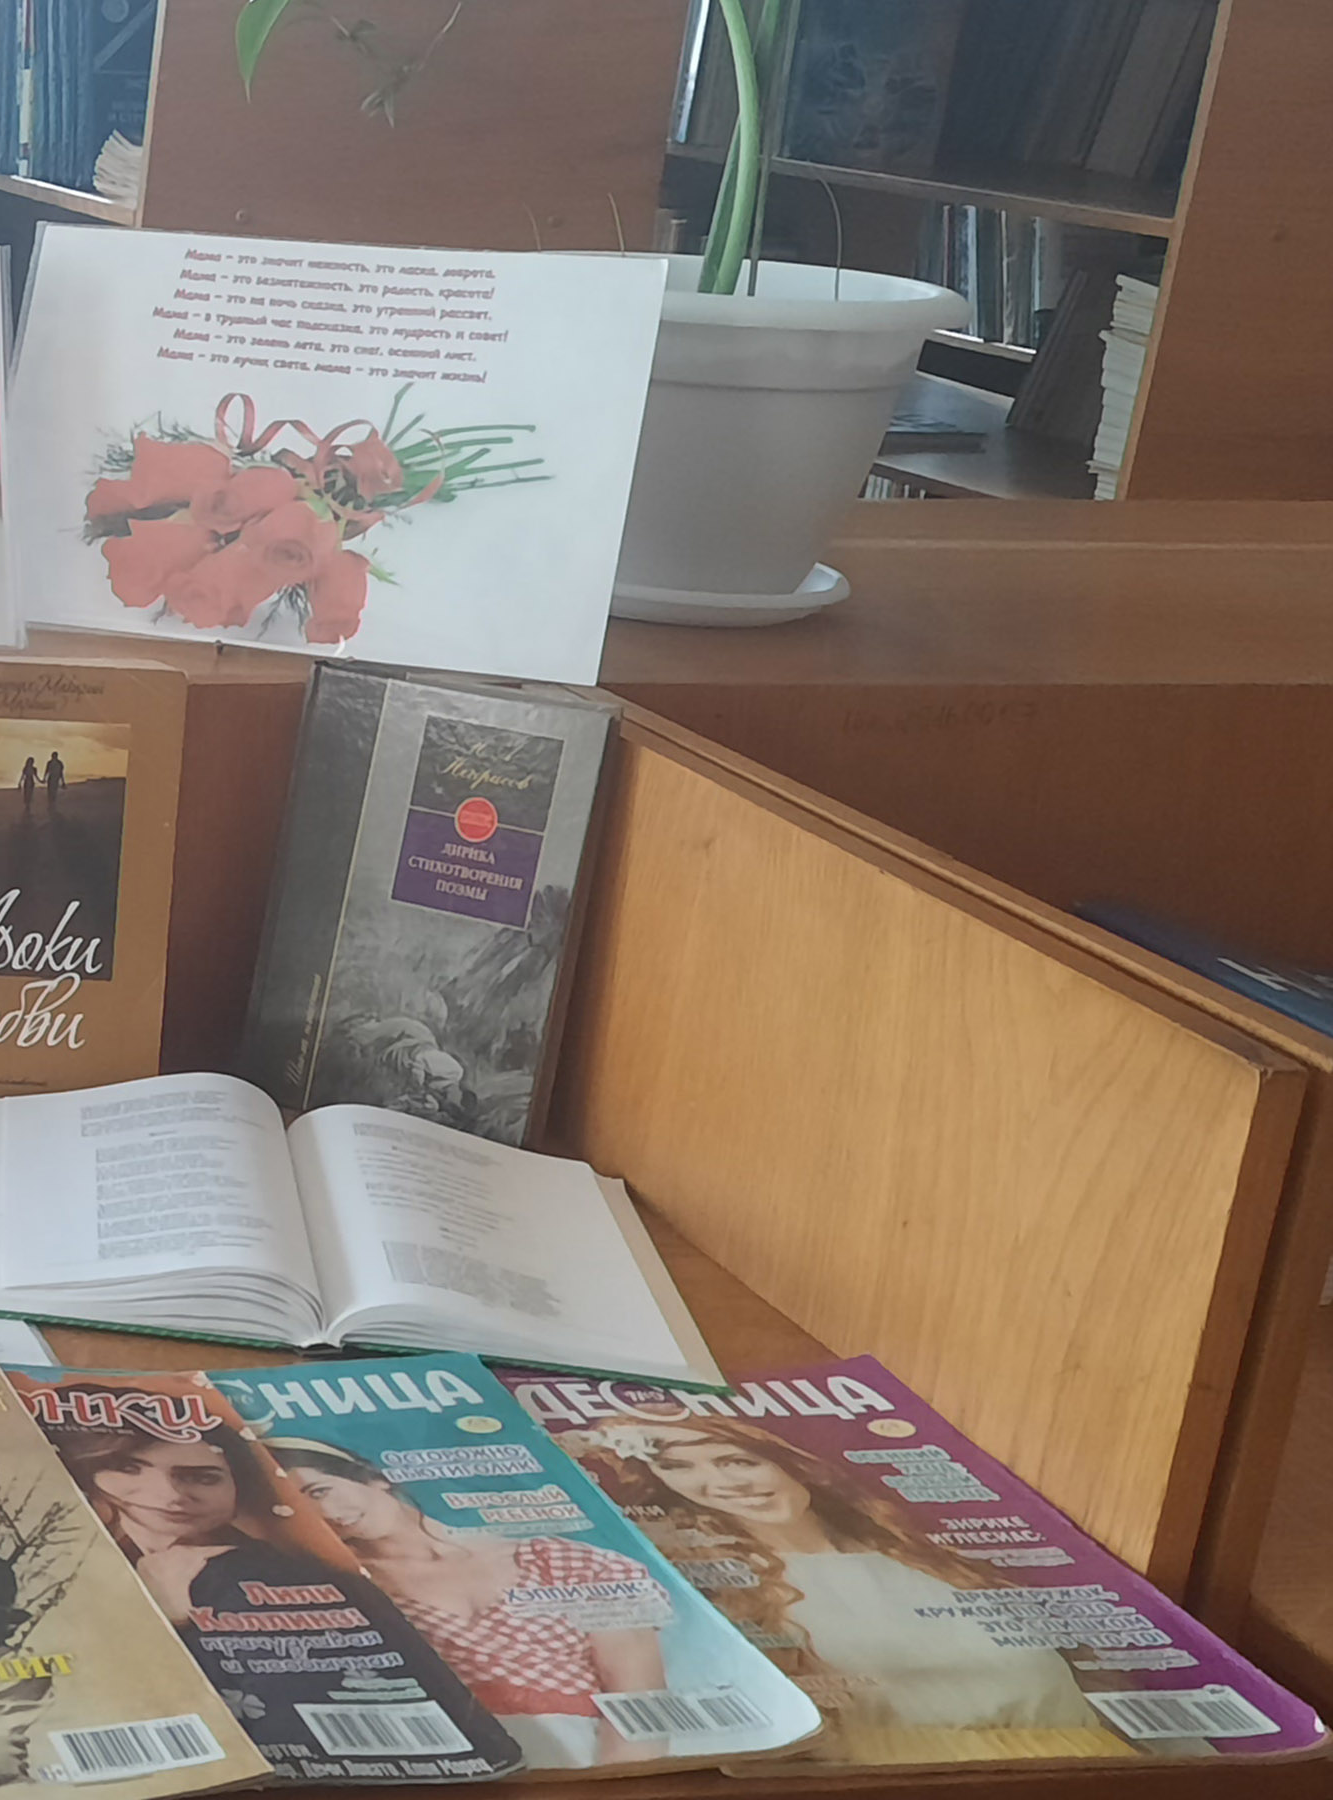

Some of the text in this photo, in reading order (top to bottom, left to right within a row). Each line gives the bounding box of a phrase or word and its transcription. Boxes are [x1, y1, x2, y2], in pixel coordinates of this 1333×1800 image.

[441, 843, 495, 864] ЛИРИКА
[408, 854, 523, 891] СТИХОТВОРЕНИЯ
[435, 879, 488, 901] ПОЭМЫ
[940, 1516, 1030, 1530] ЭНРИКЕ
[239, 1581, 346, 1605] Лили
